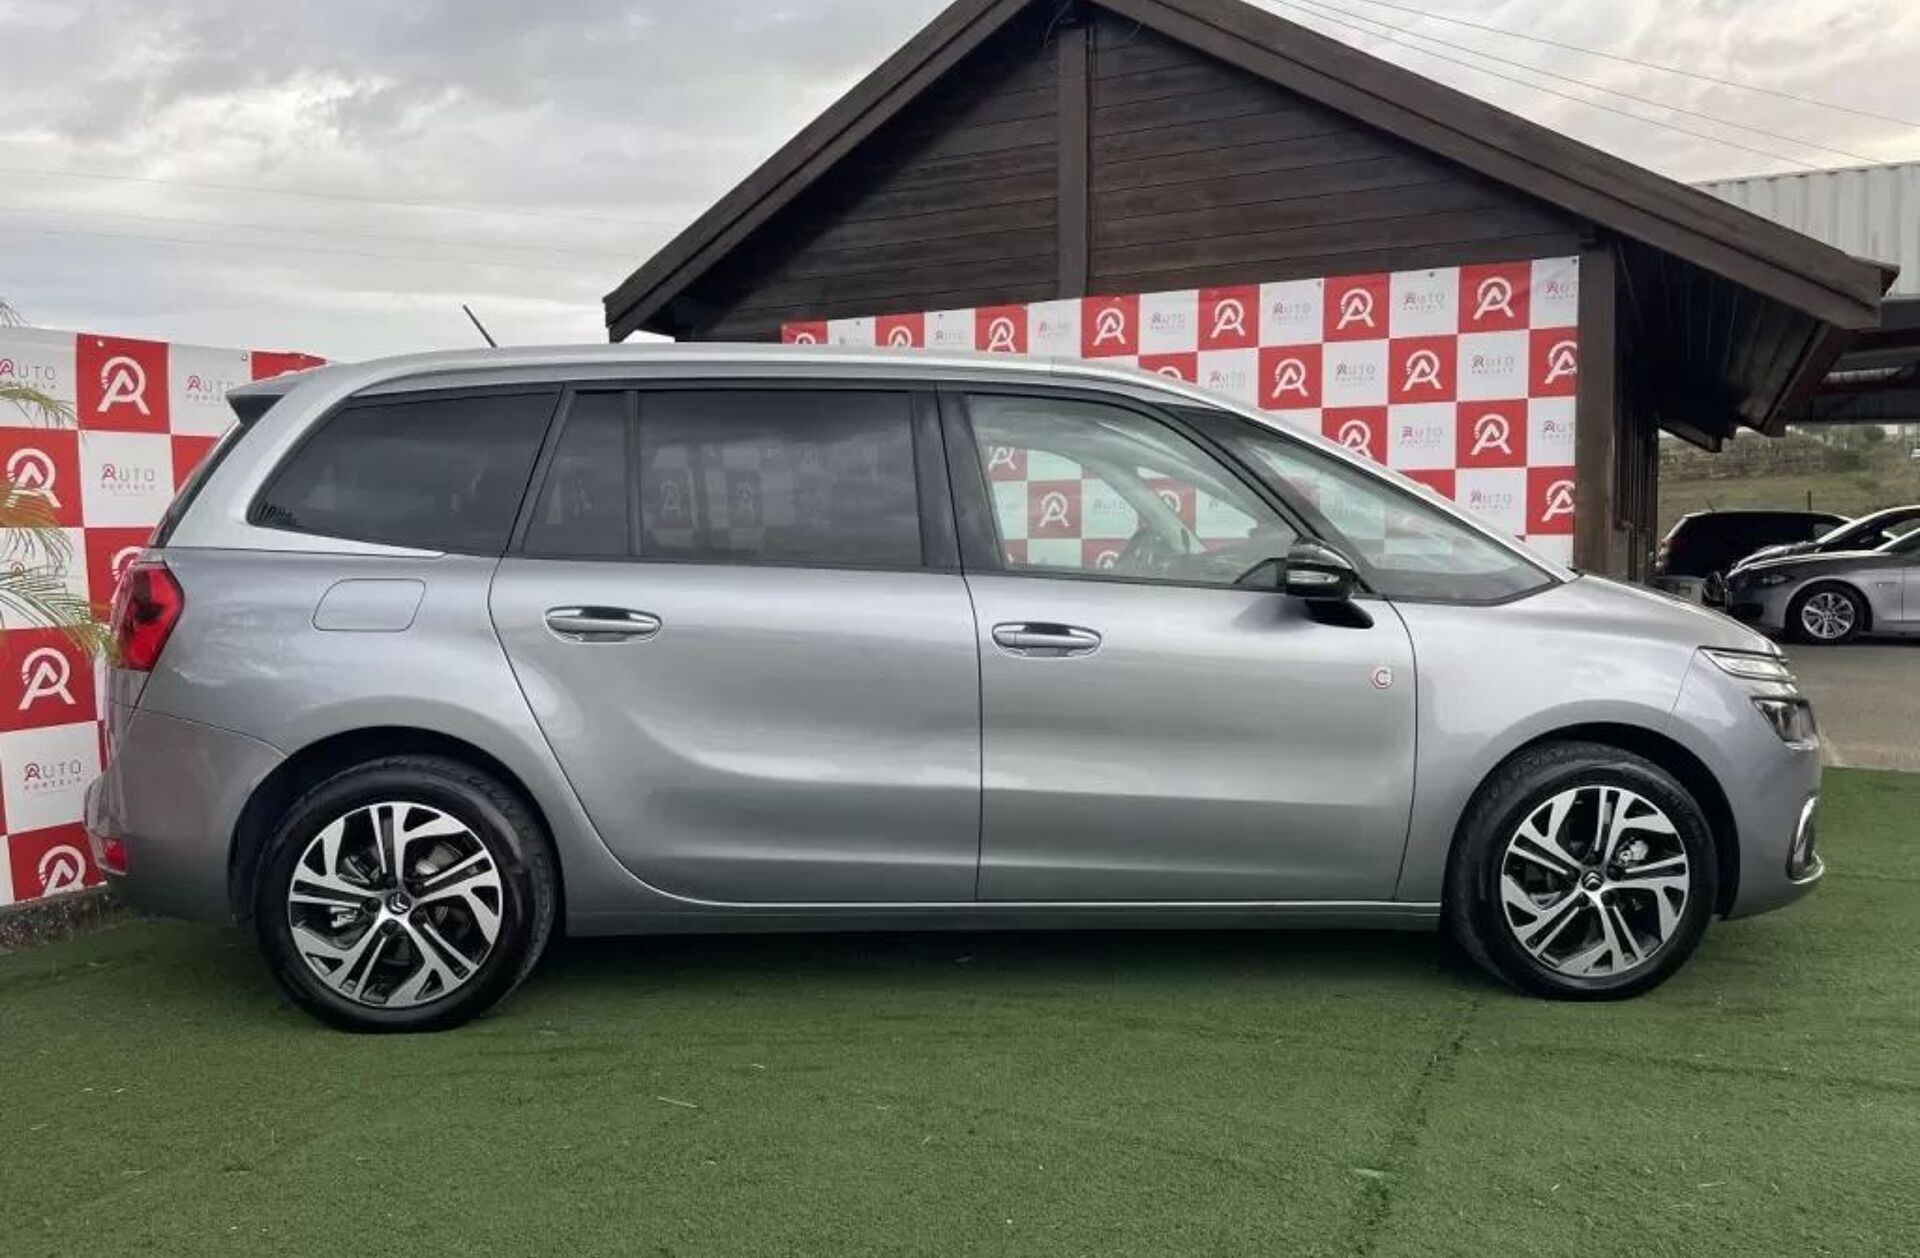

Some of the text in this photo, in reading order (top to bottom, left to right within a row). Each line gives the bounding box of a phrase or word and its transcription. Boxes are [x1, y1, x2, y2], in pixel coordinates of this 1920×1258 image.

[1471, 354, 1515, 370] AUTO
[101, 463, 156, 482] AUTO
[24, 759, 83, 781] AUTO
